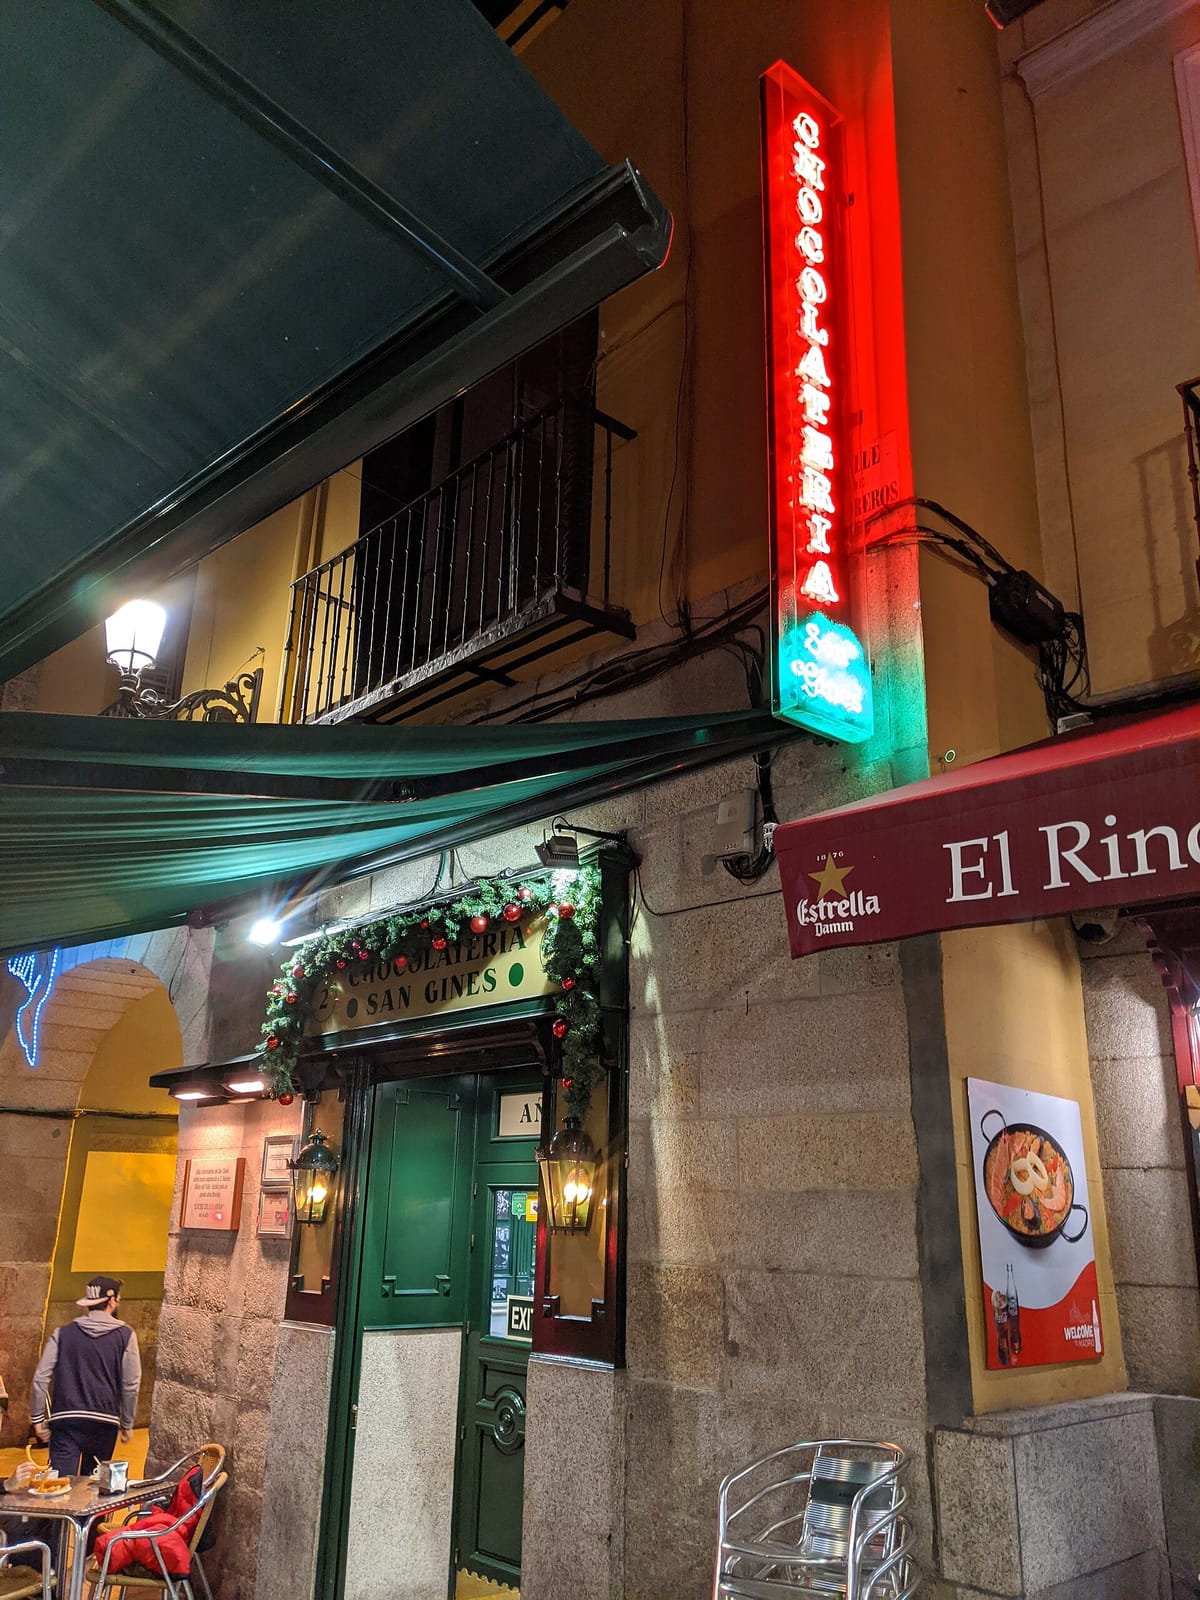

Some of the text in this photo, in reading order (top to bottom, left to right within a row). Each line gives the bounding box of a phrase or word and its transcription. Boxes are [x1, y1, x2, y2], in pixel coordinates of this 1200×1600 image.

[793, 112, 839, 603] CHOCOLATERIA
[816, 850, 845, 862] 1876
[942, 830, 1020, 903] El
[796, 889, 881, 926] Estrella
[814, 920, 855, 937] Damm
[366, 967, 498, 1015] SAN GINES
[1063, 1324, 1093, 1340] WELCOME
